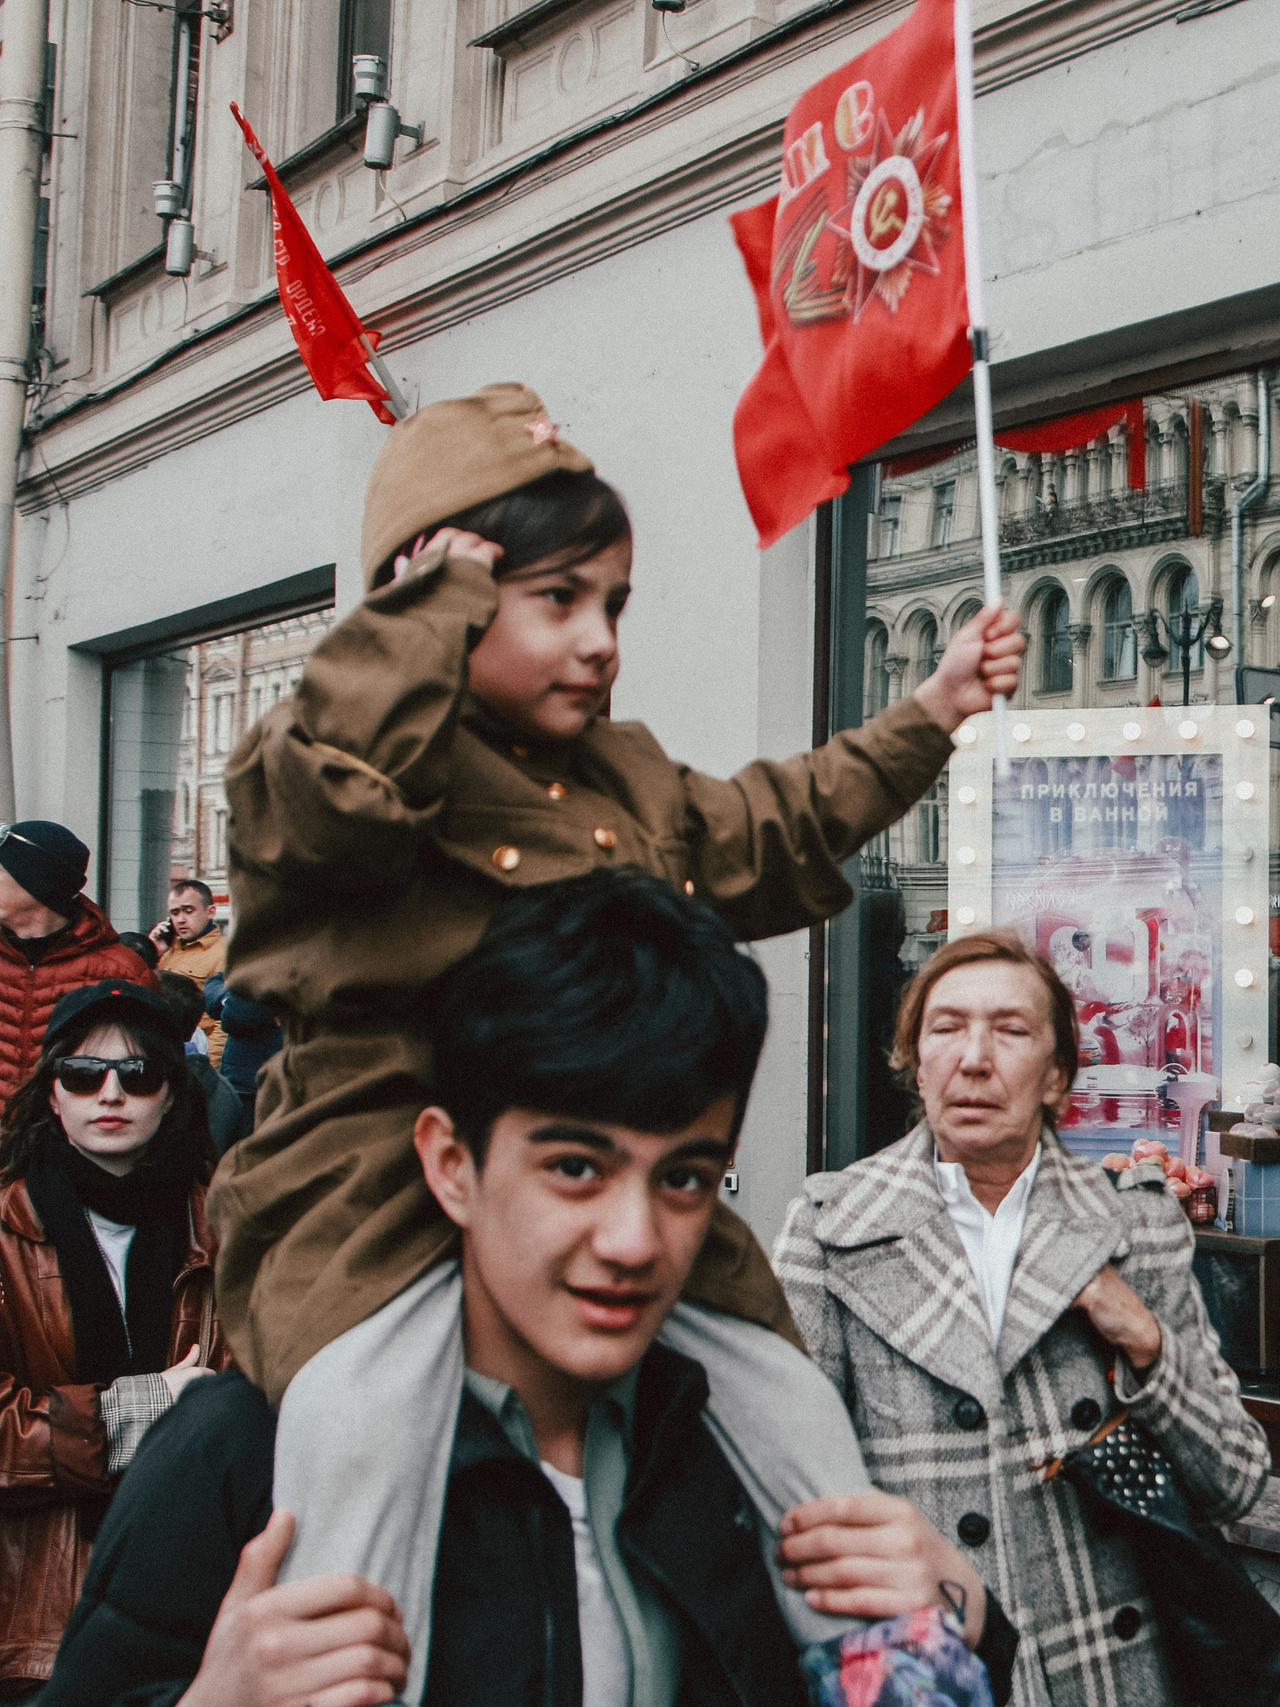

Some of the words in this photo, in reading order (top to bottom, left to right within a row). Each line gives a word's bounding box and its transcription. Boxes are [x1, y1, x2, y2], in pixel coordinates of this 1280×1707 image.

[1021, 781, 1197, 800] ПРИКЛЮЧЕНИЯ
[1050, 806, 1063, 823] В
[1074, 802, 1168, 823] ВАННОЙ
